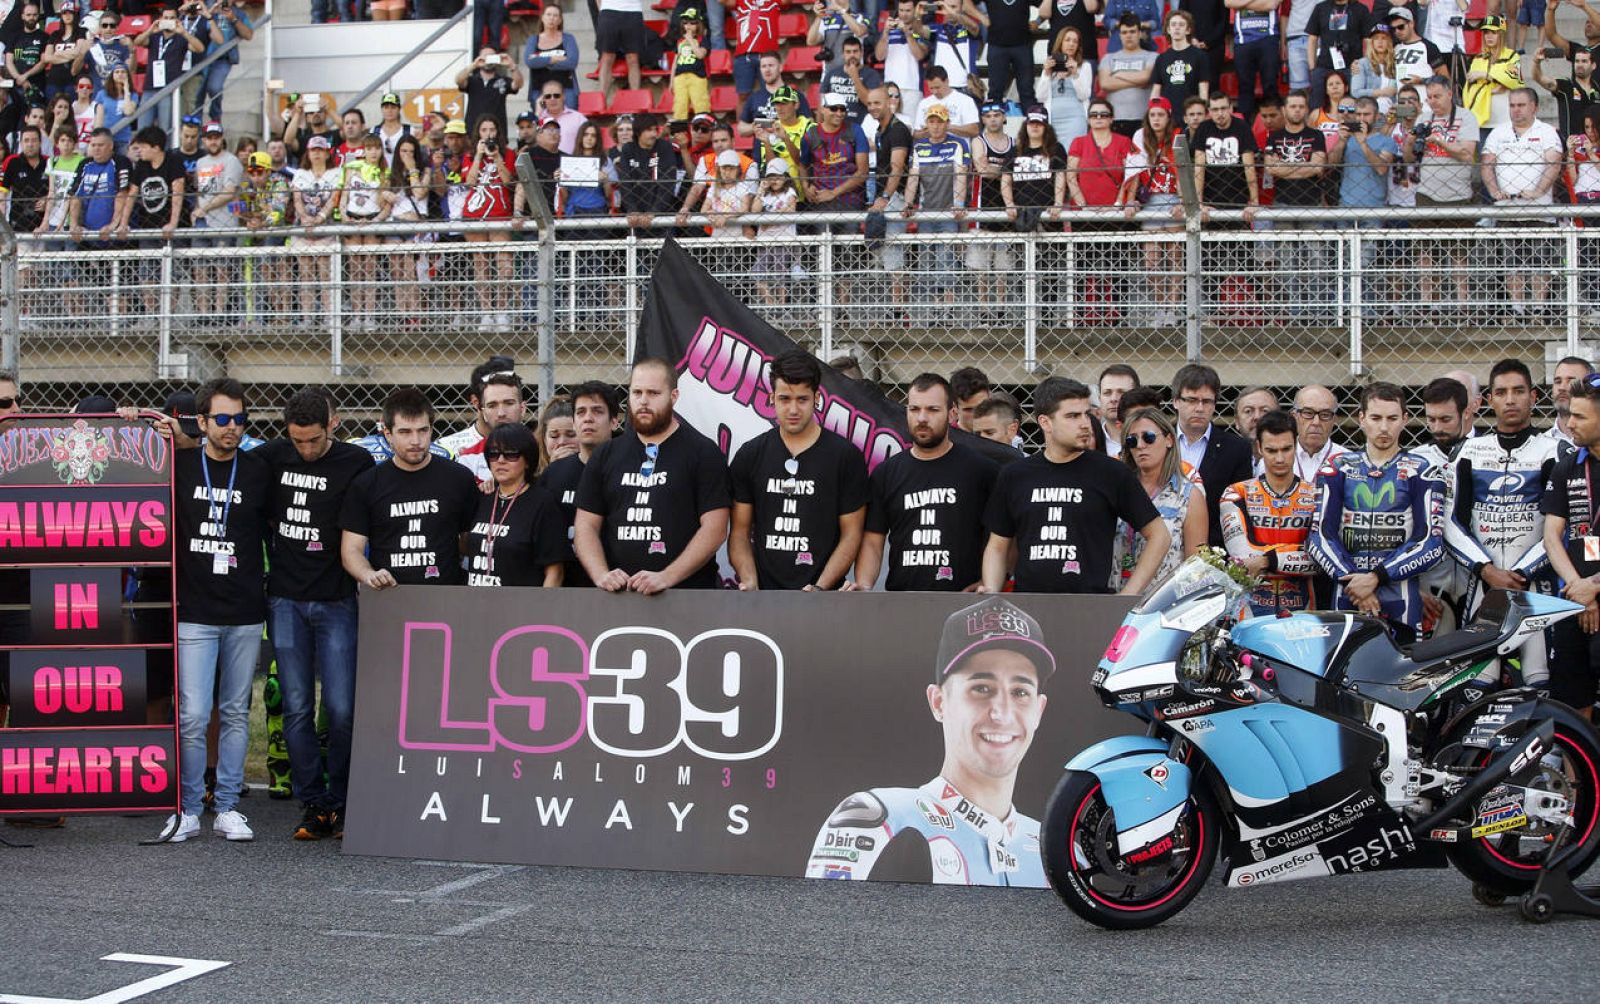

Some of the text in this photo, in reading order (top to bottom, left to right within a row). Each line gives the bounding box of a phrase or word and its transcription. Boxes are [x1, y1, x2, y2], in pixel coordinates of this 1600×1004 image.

[1395, 48, 1424, 64] 46
[413, 95, 434, 116] 11
[281, 472, 326, 490] ALWAYS
[766, 478, 815, 495] ALAYS
[294, 492, 306, 505] IN
[636, 492, 649, 504] IN
[905, 488, 955, 511] ALWAYS
[1031, 488, 1082, 502] ALWAYS
[1486, 494, 1524, 503] POWER
[391, 500, 438, 517] ALWAYS
[784, 499, 796, 513] IN
[1474, 502, 1540, 512] ELECTRONICS
[287, 508, 310, 522] OUR
[627, 508, 652, 521] OUR
[921, 510, 935, 524] IN
[1048, 507, 1062, 521] IN
[1251, 515, 1312, 528] REPSOL
[1352, 514, 1405, 526] ENEOS
[1479, 512, 1535, 523] PULL&BEAR
[0, 500, 166, 548] ALWAYS
[409, 519, 420, 532] IN
[775, 517, 800, 532] OUR
[280, 523, 319, 541] HEARTS
[618, 526, 661, 540] HEARTS
[913, 530, 940, 545] OUR
[1041, 526, 1066, 540] OUR
[1353, 533, 1403, 542] MONSTER
[401, 536, 425, 548] OUR
[766, 535, 808, 551] HEARTS
[391, 552, 435, 566] HEARTS
[903, 551, 949, 566] HEARTS
[1030, 545, 1076, 560] HEARTS
[1308, 541, 1336, 579] YAMAHA
[1398, 545, 1443, 576] movistar
[54, 583, 99, 630] IN
[1279, 595, 1303, 607] Bull
[33, 665, 124, 714] OUR
[398, 621, 785, 761] LS39
[1163, 698, 1215, 716] Camarón
[2, 745, 168, 794] HEARTS
[420, 791, 751, 836] ALWAYS
[1265, 795, 1376, 848] Colomer & Sons
[1485, 817, 1525, 833] DUNLOP
[1285, 834, 1311, 848] Pasión
[1312, 829, 1325, 841] por
[1326, 817, 1413, 875] nashi
[1131, 837, 1173, 864] PROJECTS
[1256, 852, 1315, 880] merefsa
